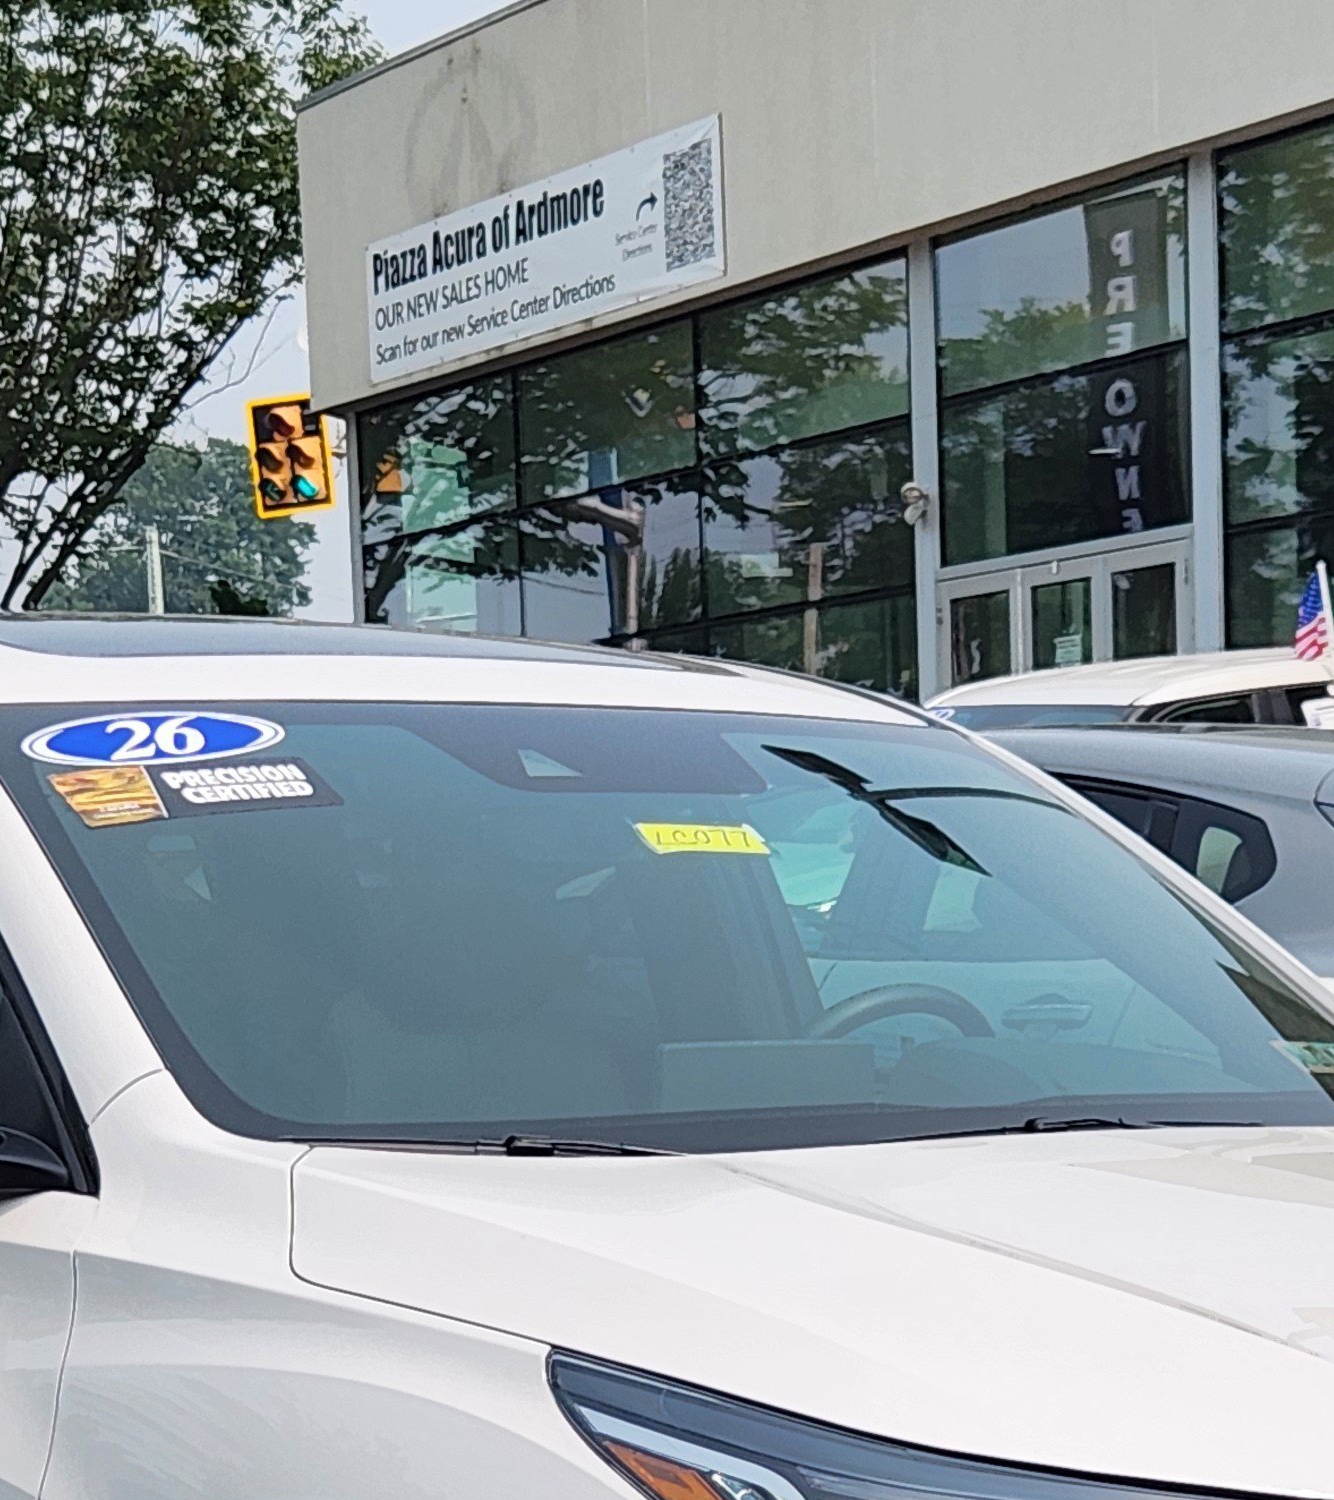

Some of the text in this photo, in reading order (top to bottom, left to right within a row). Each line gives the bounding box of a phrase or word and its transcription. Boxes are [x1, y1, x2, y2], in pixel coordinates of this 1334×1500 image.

[372, 178, 604, 295] Piazza Acura of Ardmore
[375, 257, 530, 332] OUR NEW SALES HOME
[376, 273, 616, 366] Scan for our new Service Center Directions
[104, 716, 206, 761] 26
[160, 763, 308, 790] PRECISION
[181, 779, 314, 804] CERTIFIED
